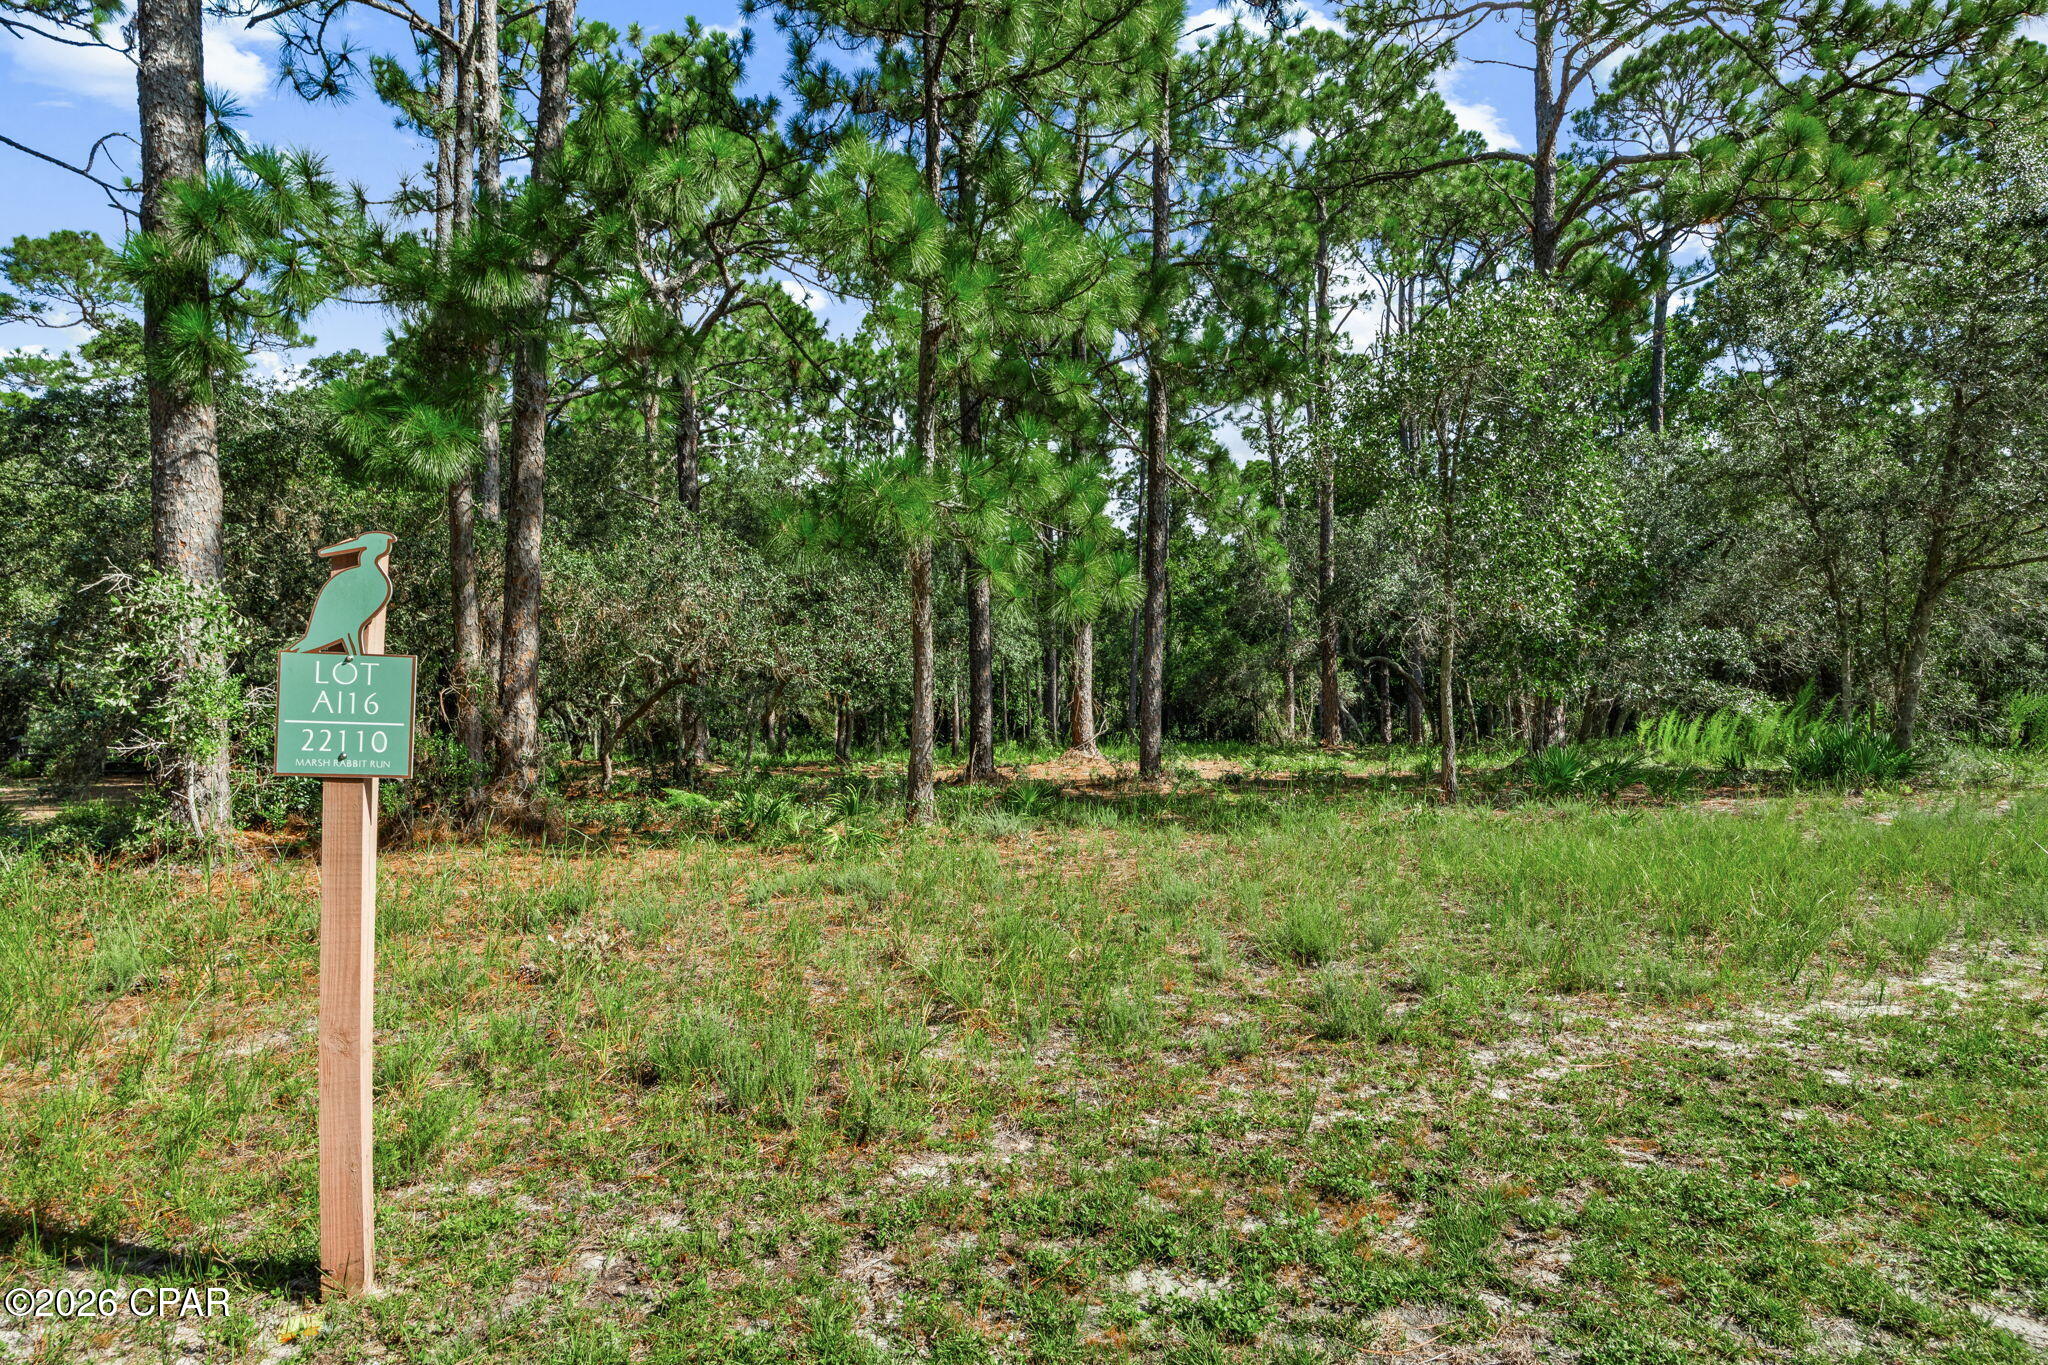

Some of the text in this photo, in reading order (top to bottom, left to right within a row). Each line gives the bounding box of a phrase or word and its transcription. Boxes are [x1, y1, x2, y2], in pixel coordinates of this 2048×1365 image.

[315, 660, 380, 685] LOT
[301, 728, 388, 753] 22110
[295, 758, 391, 768] MARSH RABBIT RUN
